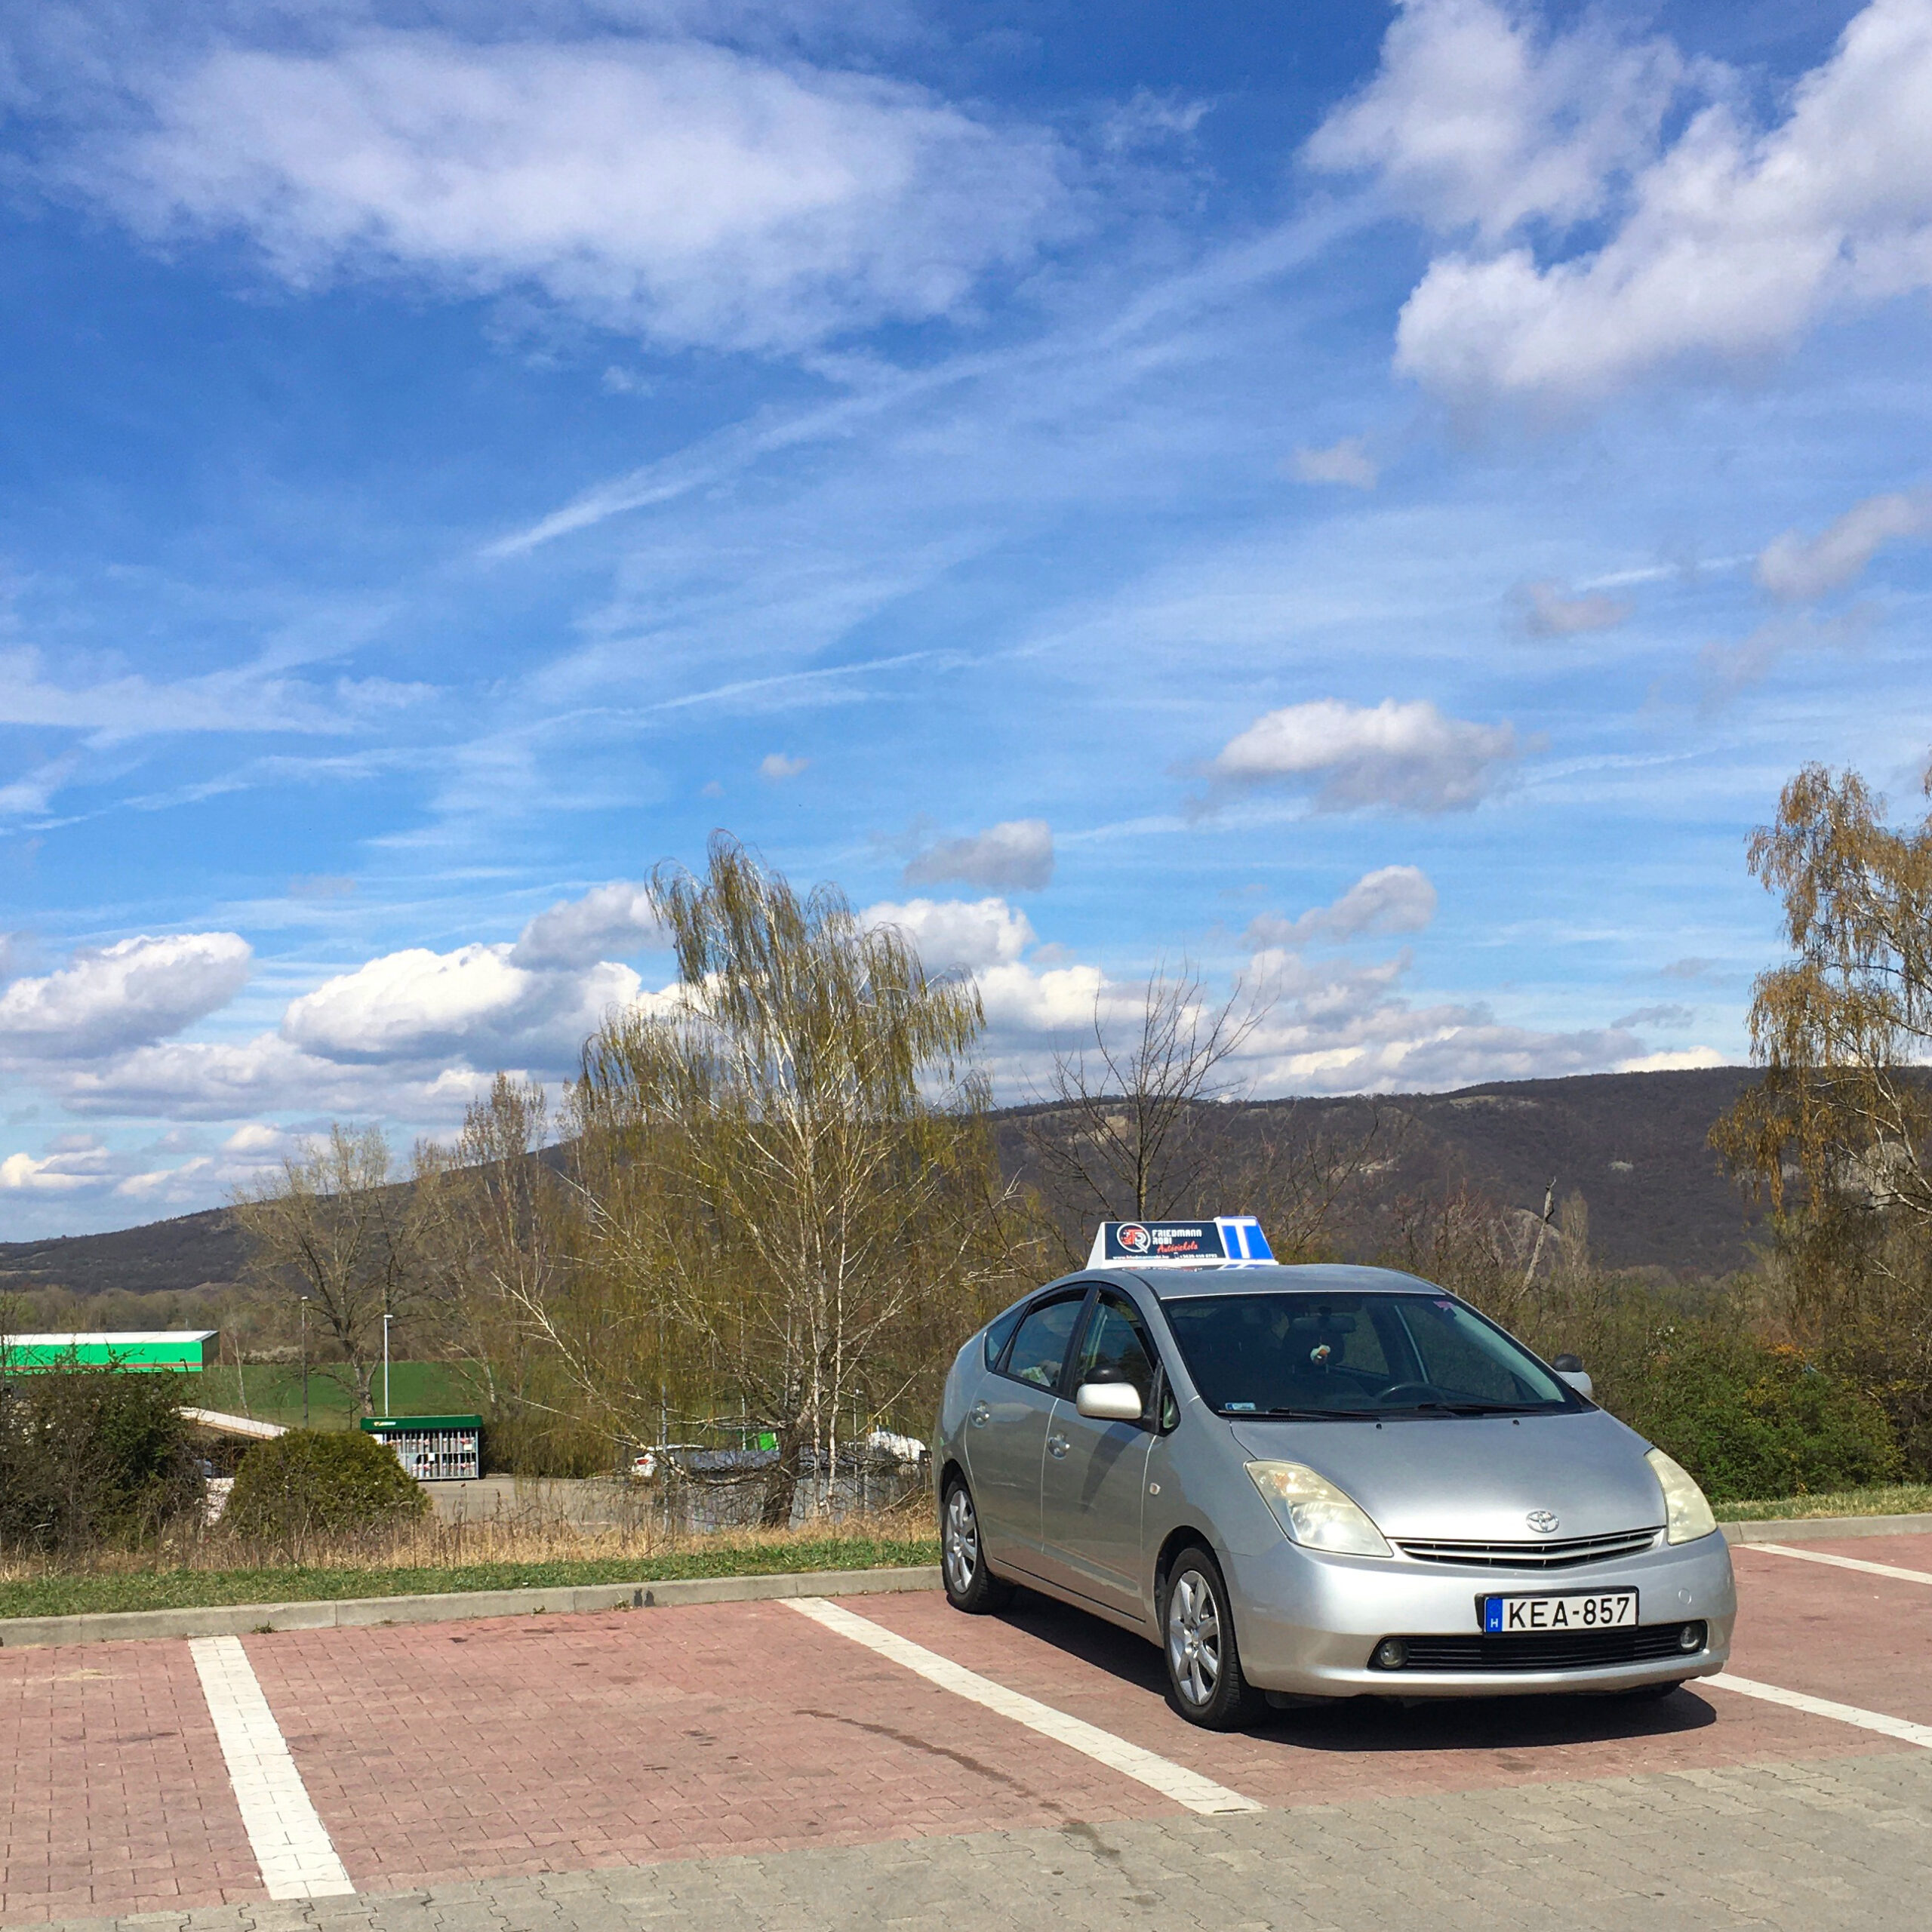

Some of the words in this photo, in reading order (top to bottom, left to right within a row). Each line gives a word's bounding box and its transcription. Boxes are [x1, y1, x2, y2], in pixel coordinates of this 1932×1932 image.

[1220, 1219, 1257, 1260] T
[1491, 1618, 1499, 1628] H
[1509, 1597, 1630, 1628] KEA-857
